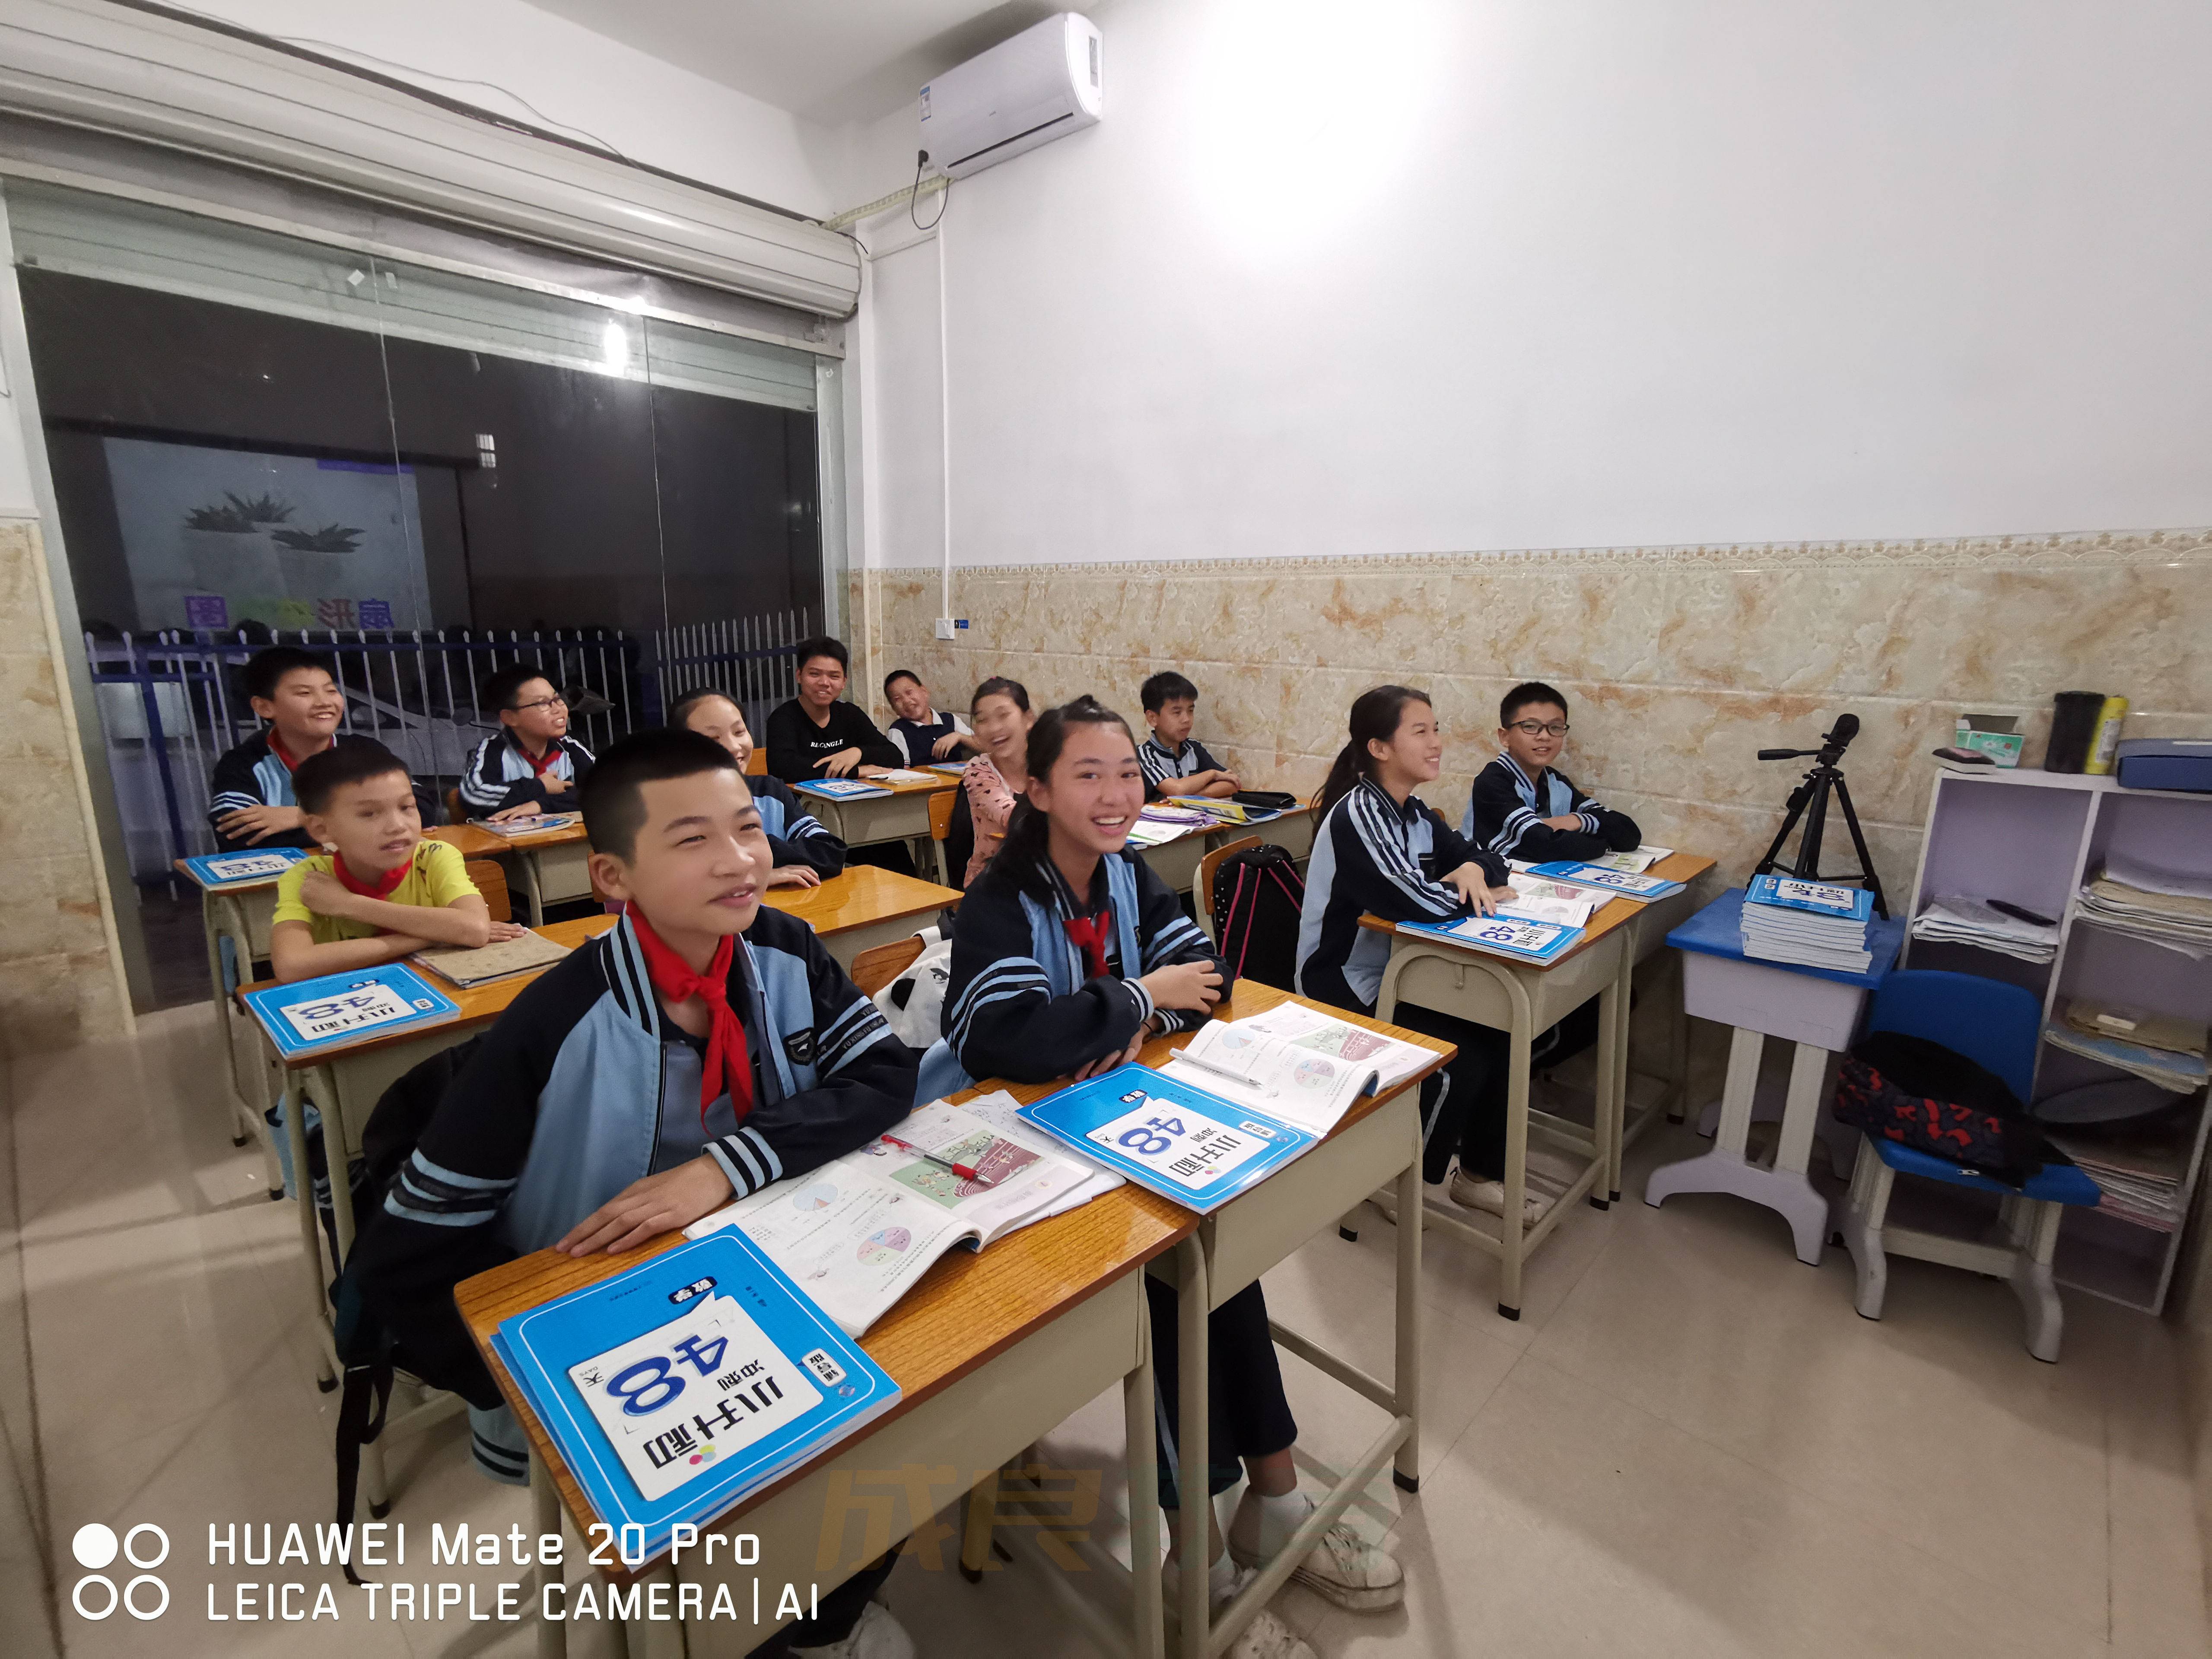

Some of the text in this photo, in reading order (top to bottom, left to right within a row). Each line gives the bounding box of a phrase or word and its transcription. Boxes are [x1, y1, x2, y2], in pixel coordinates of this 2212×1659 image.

[1480, 926, 1515, 940] 48
[298, 996, 375, 1019] 48
[1118, 1117, 1186, 1155] 48
[1169, 1135, 1242, 1176] 小升初
[583, 1333, 730, 1417] 48 天
[717, 1359, 765, 1391] 冲刺
[643, 1376, 783, 1469] 小升初
